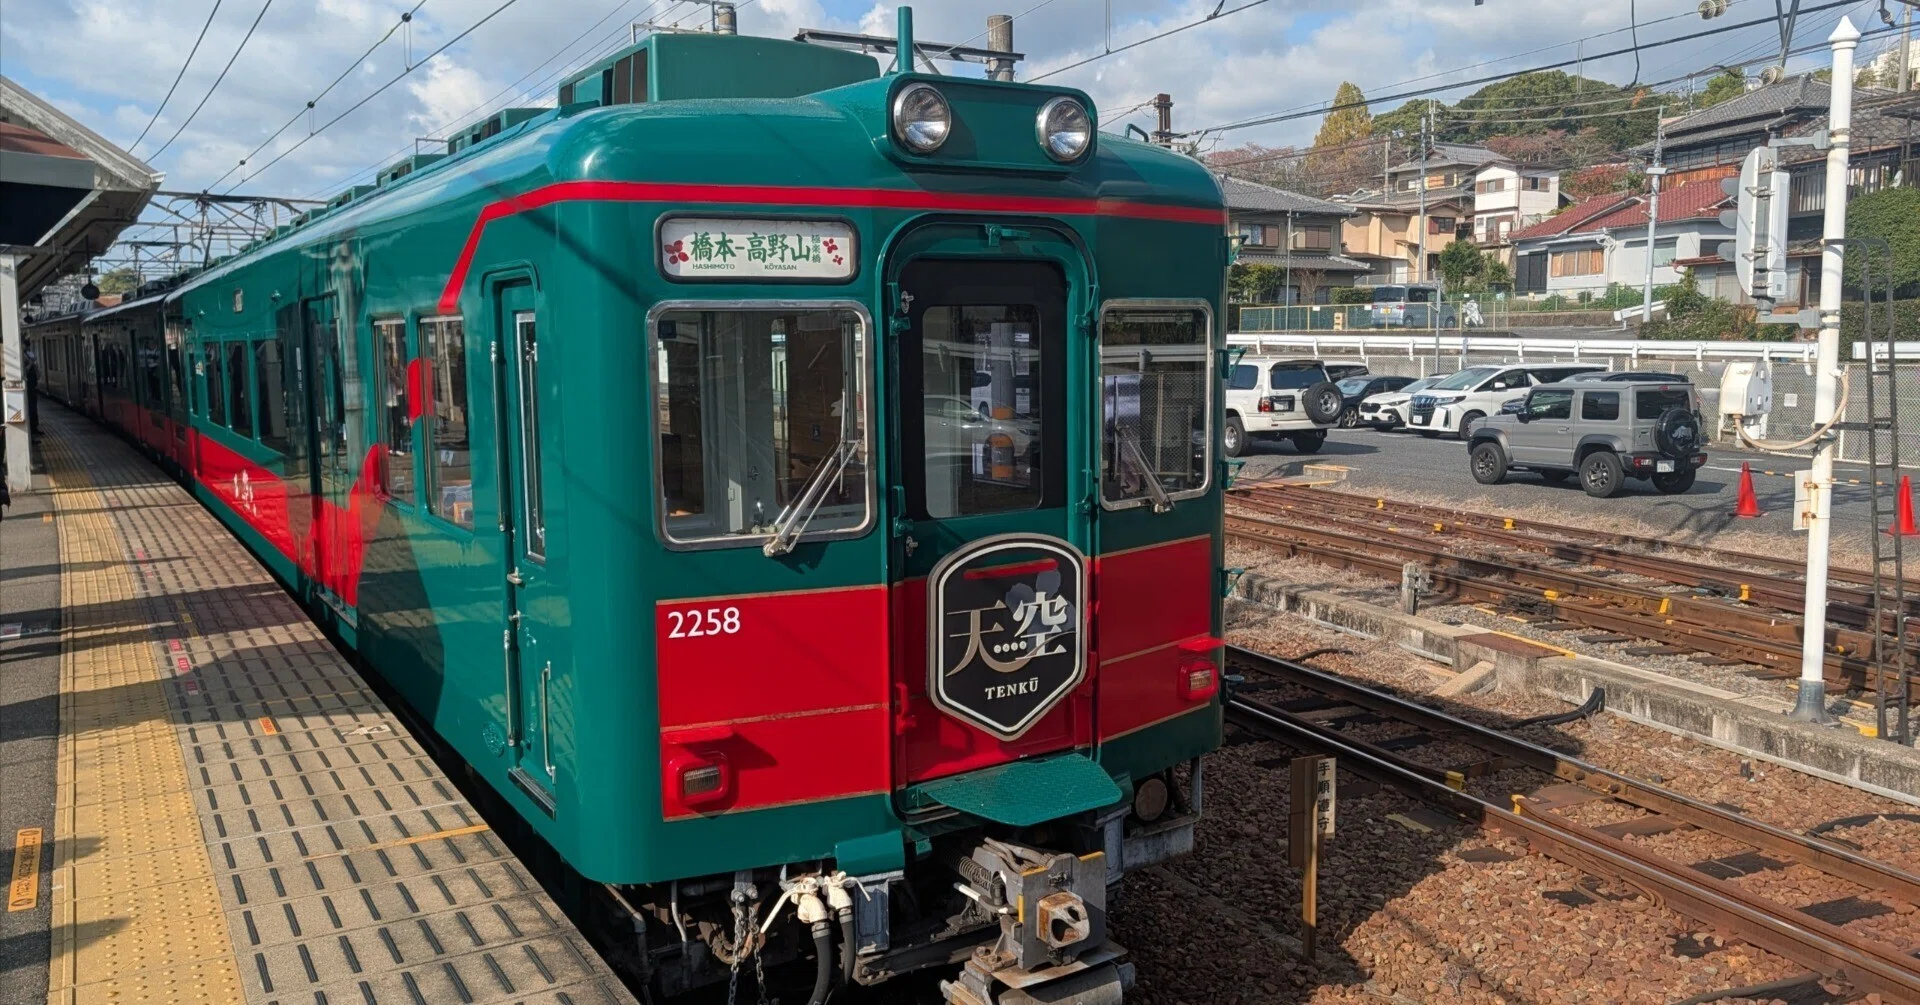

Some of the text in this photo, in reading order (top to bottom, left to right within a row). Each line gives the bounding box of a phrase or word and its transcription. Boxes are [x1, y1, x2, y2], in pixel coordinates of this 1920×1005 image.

[668, 606, 741, 639] 2258
[945, 591, 1069, 678] 天空
[984, 677, 1039, 700] TENKŪ
